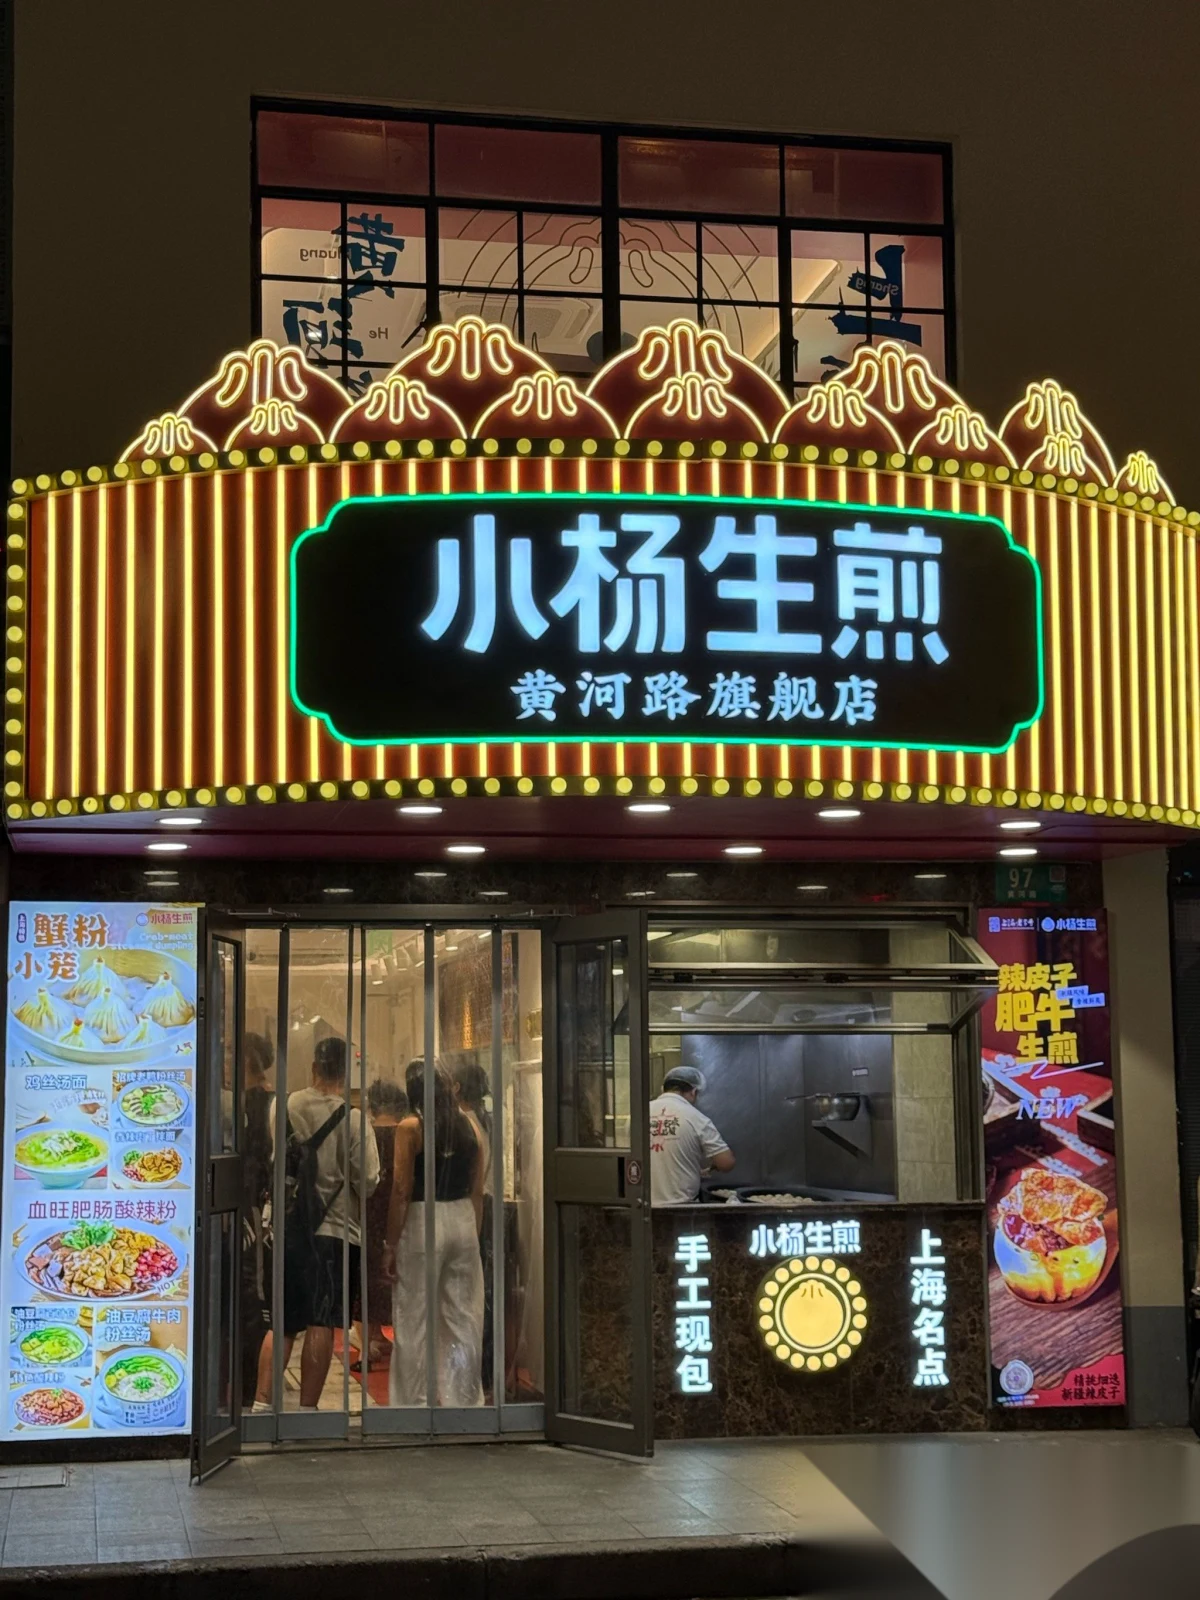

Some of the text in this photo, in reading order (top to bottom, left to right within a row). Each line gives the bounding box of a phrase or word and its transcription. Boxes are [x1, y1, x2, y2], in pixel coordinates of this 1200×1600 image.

[420, 513, 950, 665] 小杨生煎
[510, 670, 881, 726] 黄河路旗舰店
[1009, 868, 1034, 888] 97
[33, 913, 108, 948] 蟹粉
[15, 951, 78, 980] 小笼
[998, 962, 1077, 991] 辣皮子
[995, 991, 1075, 1033] 肥牛
[1016, 1032, 1079, 1065] 生煎
[25, 1075, 87, 1090] 鸡丝汤面
[1016, 1097, 1078, 1120] NEW
[28, 1200, 177, 1220] 血旺肥肠酸辣粉
[748, 1220, 862, 1258] 小杨生煎
[157, 1280, 177, 1294] HOT
[105, 1308, 182, 1325] 油豆腐牛肉
[674, 1234, 713, 1394] 手工现包
[909, 1228, 950, 1388] 上海名点
[105, 1326, 152, 1343] 粉丝汤
[1062, 1386, 1121, 1401] 新疆辣皮子
